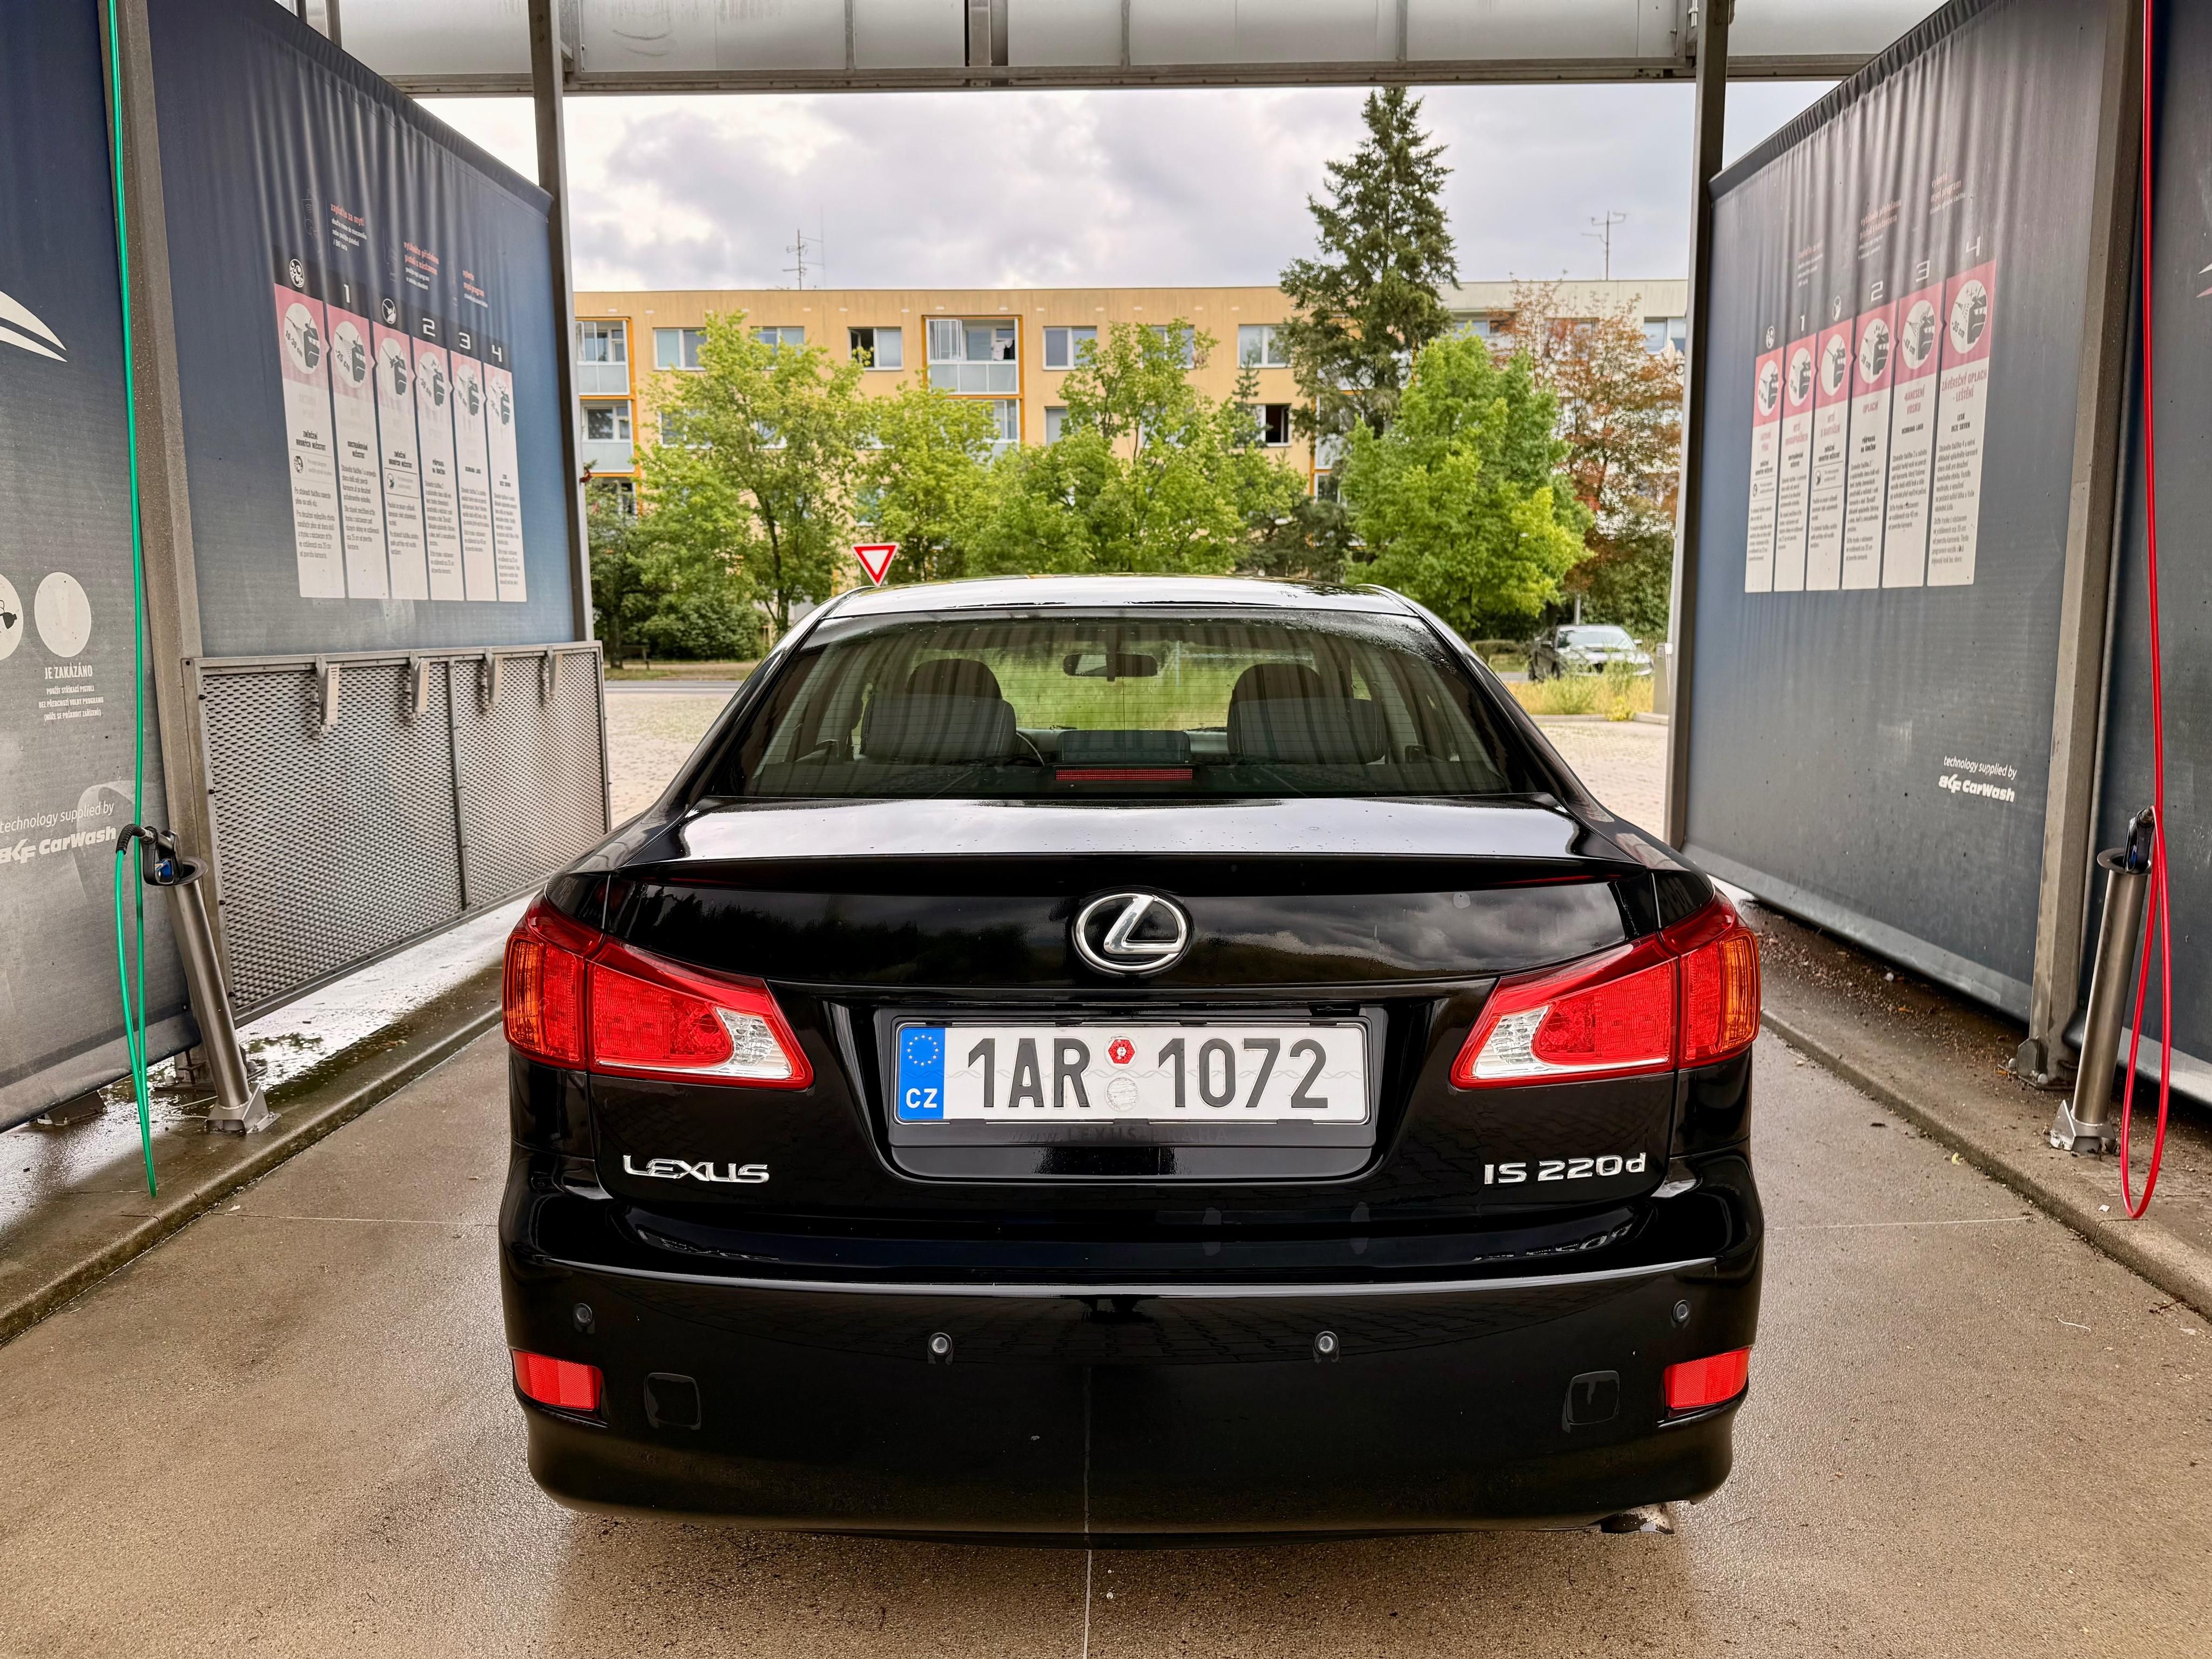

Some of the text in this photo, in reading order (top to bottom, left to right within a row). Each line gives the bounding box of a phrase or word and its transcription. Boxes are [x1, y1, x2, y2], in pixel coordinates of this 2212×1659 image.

[1966, 236, 1981, 257] 4
[1916, 260, 1930, 282] 3
[343, 284, 350, 303] 1
[1871, 280, 1883, 302] 2
[422, 318, 435, 337] 2
[1800, 314, 1805, 331] 1
[458, 332, 471, 350] 3
[297, 347, 303, 358] cm
[491, 345, 502, 362] 4
[343, 361, 350, 372] cm
[1941, 369, 1987, 391] ZÁVĚREČNÝ OPLACH
[1956, 385, 1974, 402] LEŠTĚNÍ
[45, 662, 92, 679] JE ZAKÁZÁNO
[46, 686, 60, 694] POUŽÍT
[83, 697, 104, 705] PROGRAMU
[1944, 756, 2017, 780] technology supplied by
[1963, 779, 2015, 802] CarWash
[0, 800, 114, 833] technology supplied by
[38, 826, 116, 854] CarWash
[968, 1037, 1328, 1109] 1AR 1072
[905, 1087, 938, 1109] CZ
[622, 1155, 771, 1184] LEXUS
[1484, 1152, 1647, 1185] IS 220d
